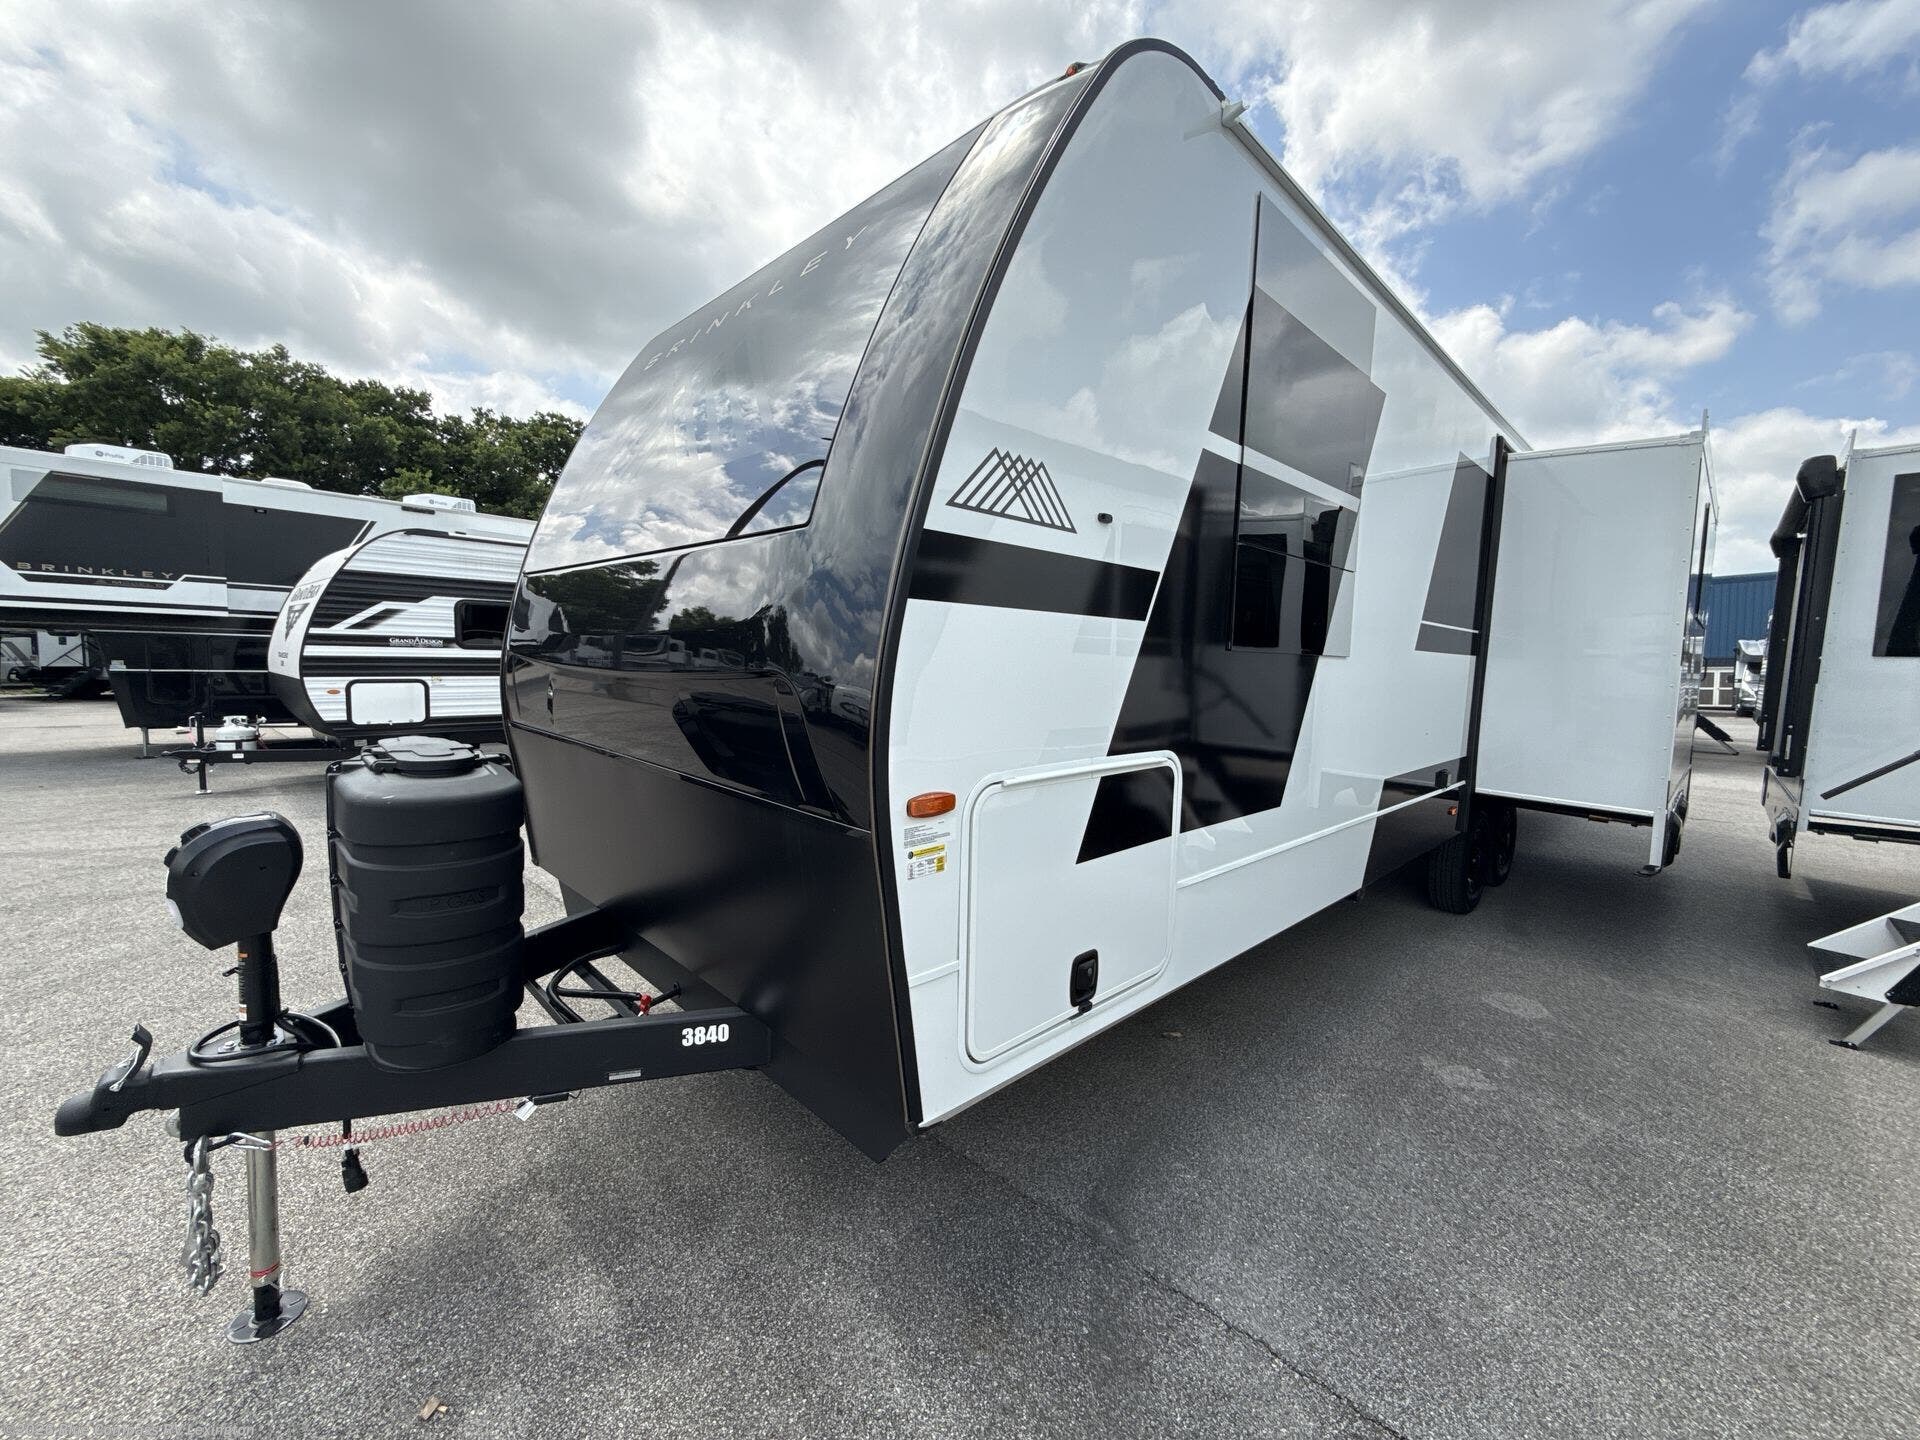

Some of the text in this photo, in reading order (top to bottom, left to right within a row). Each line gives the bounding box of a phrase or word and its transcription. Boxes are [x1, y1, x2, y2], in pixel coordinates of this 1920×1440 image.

[643, 224, 869, 371] BRINKLEY
[16, 561, 174, 579] BRINKLEY
[681, 1023, 730, 1047] 3840
